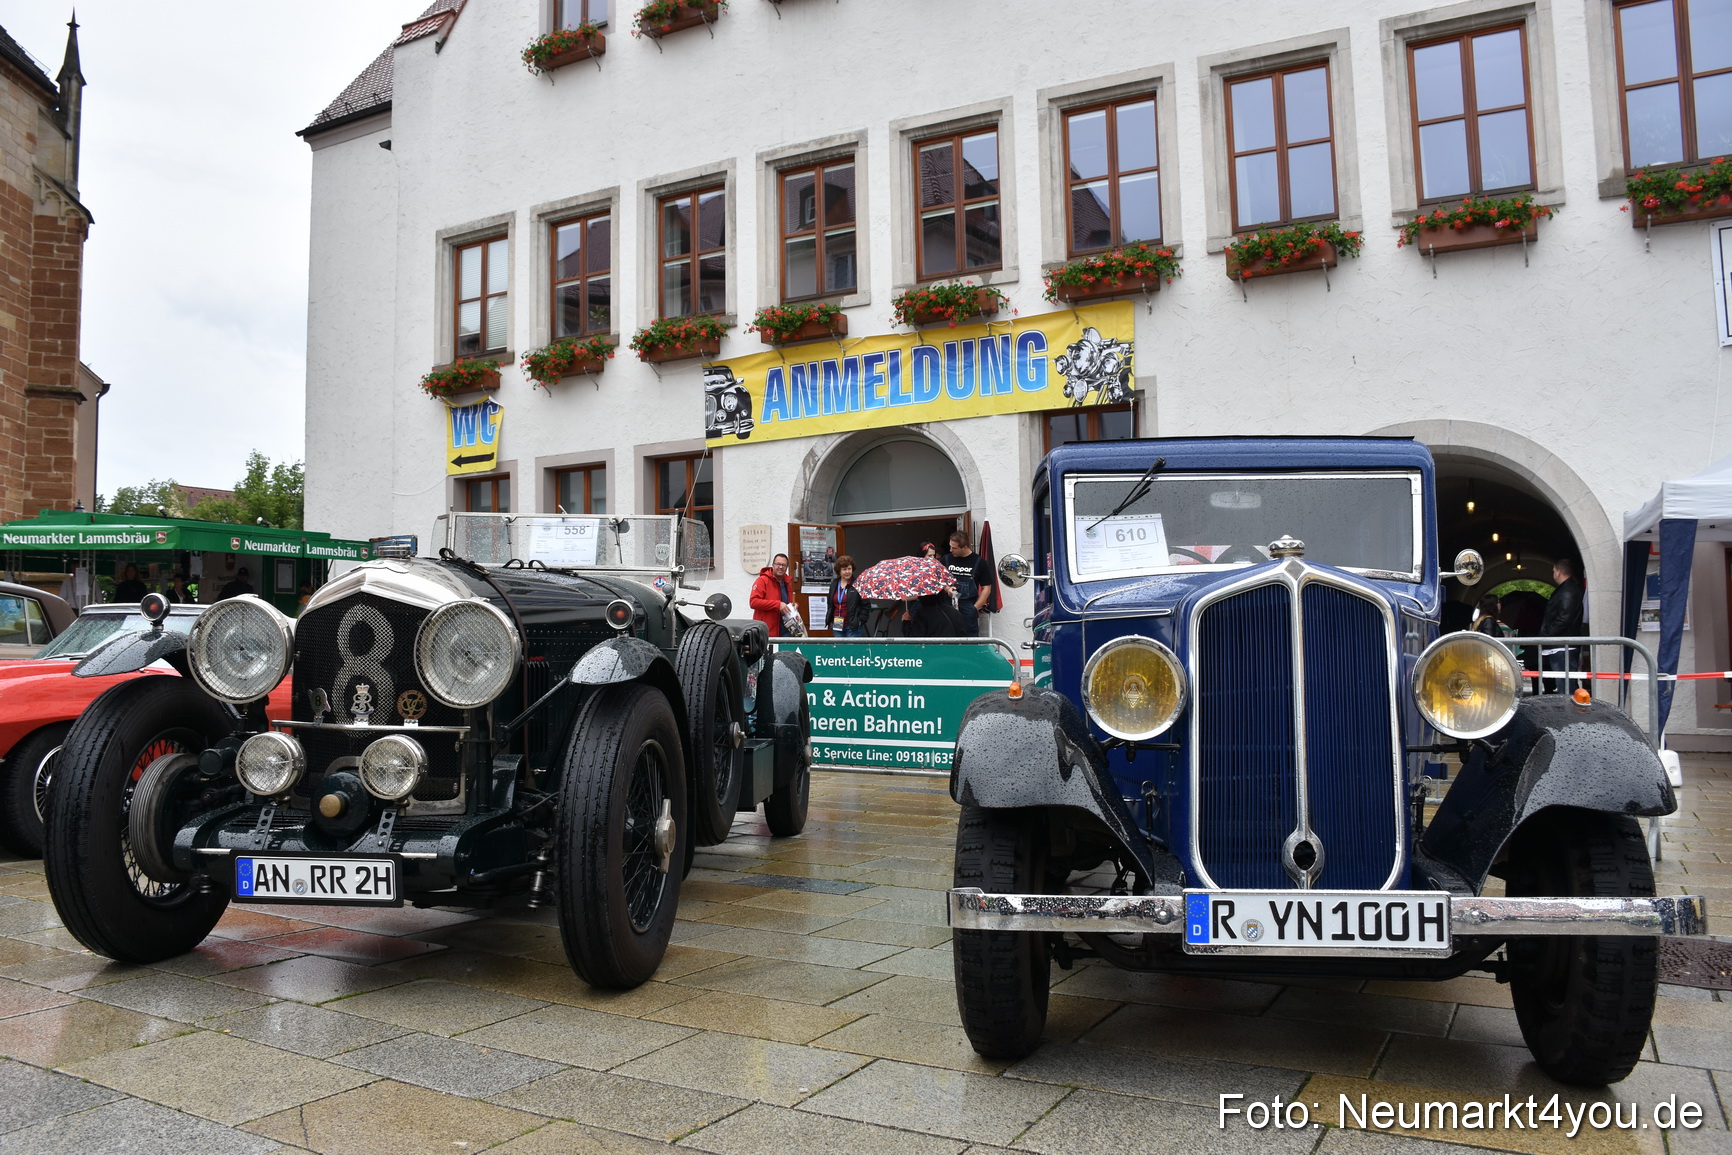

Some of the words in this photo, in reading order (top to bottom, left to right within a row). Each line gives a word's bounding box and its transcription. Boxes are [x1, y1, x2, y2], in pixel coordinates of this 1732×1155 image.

[760, 329, 1049, 423] ANMELDUNG
[450, 400, 499, 448] WC
[3, 532, 75, 544] Neumarkter
[79, 532, 150, 544] Lammsbräu
[564, 525, 586, 535] 558
[1115, 528, 1146, 542] 610
[244, 540, 301, 554] Neumarkter
[306, 543, 357, 558] Lammsbräu
[815, 655, 923, 669] Event-Leit-Systeme
[823, 689, 837, 706] &
[841, 690, 901, 708] Action
[908, 690, 925, 708] in
[809, 712, 857, 731] heren
[864, 715, 942, 734] Bahnen!
[812, 746, 821, 757] &
[824, 747, 863, 760] Service
[866, 749, 893, 761] Line:
[242, 881, 249, 889] D
[254, 863, 290, 892] AN
[310, 865, 348, 894] RR
[355, 866, 392, 895] 2H
[1193, 925, 1201, 936] D
[1212, 900, 1237, 939] R
